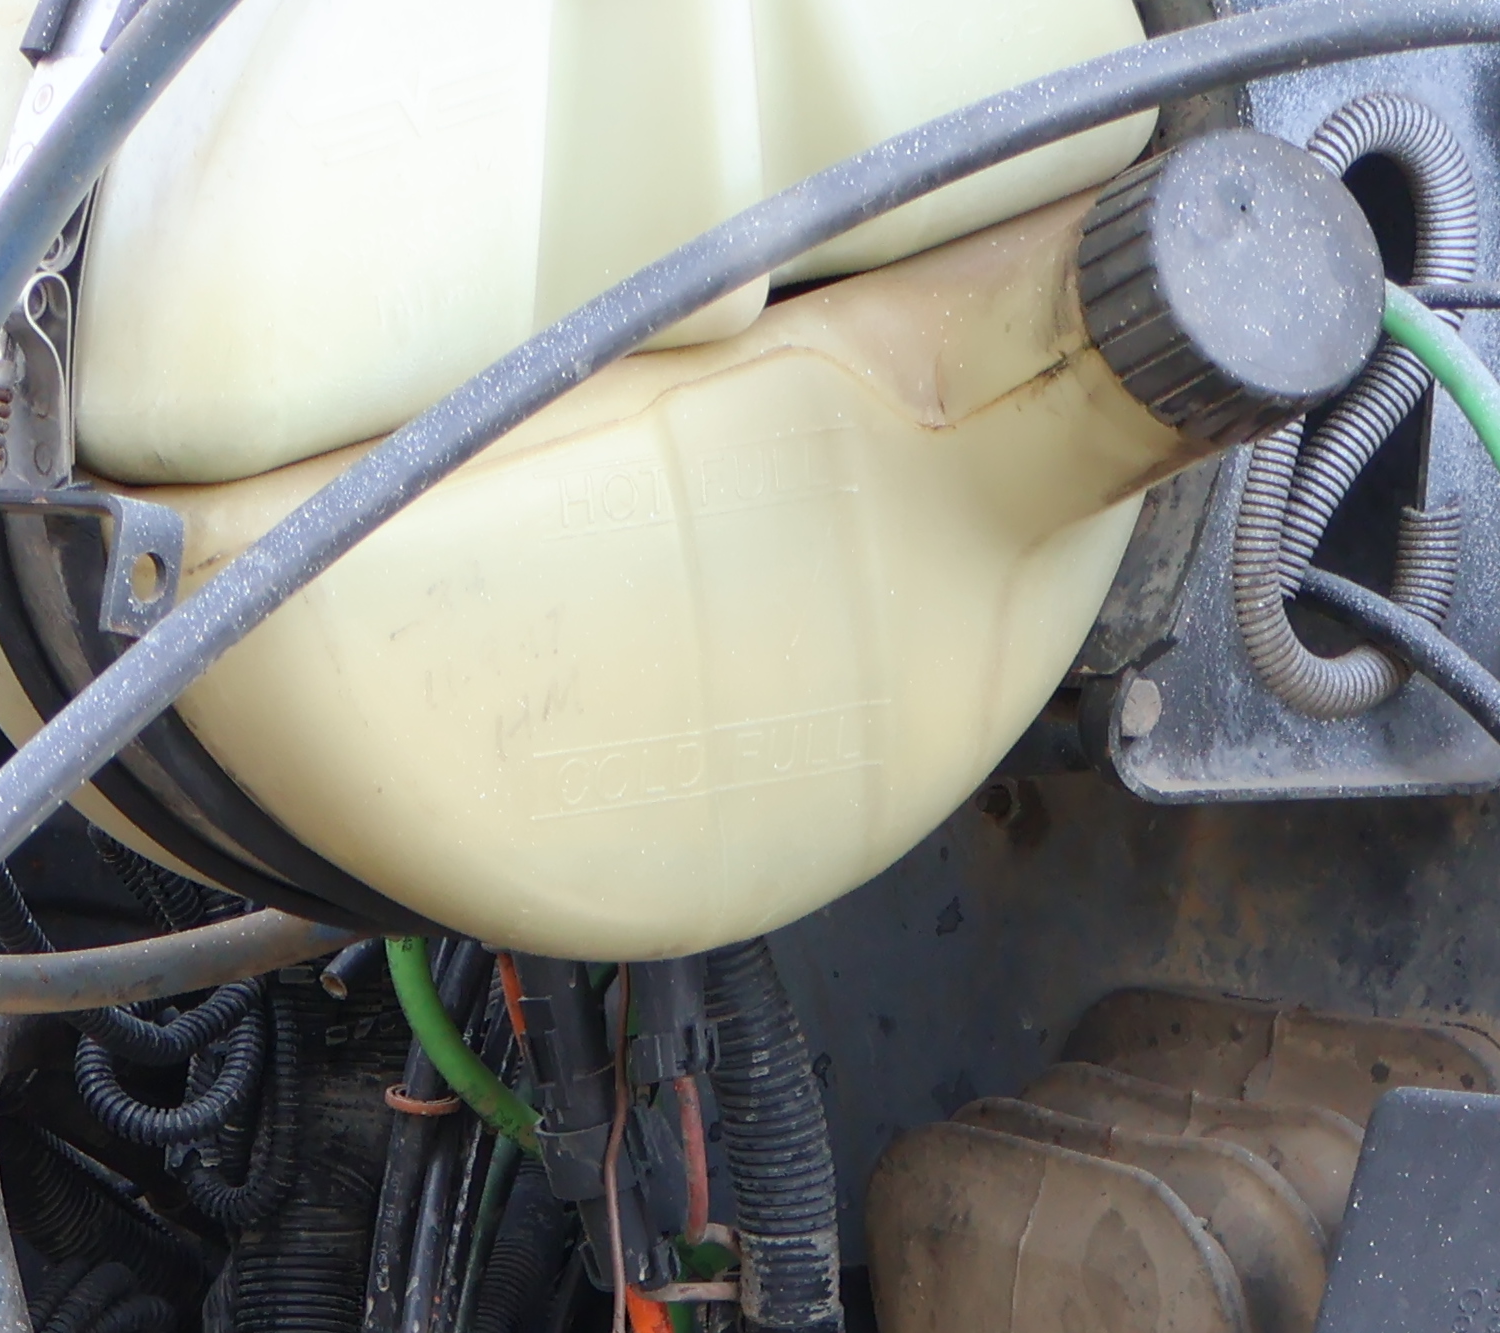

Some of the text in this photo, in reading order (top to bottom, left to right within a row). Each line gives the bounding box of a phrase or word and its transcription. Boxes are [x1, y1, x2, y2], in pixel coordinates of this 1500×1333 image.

[559, 435, 830, 528] HOT FULL
[556, 714, 862, 806] COLD FULL
